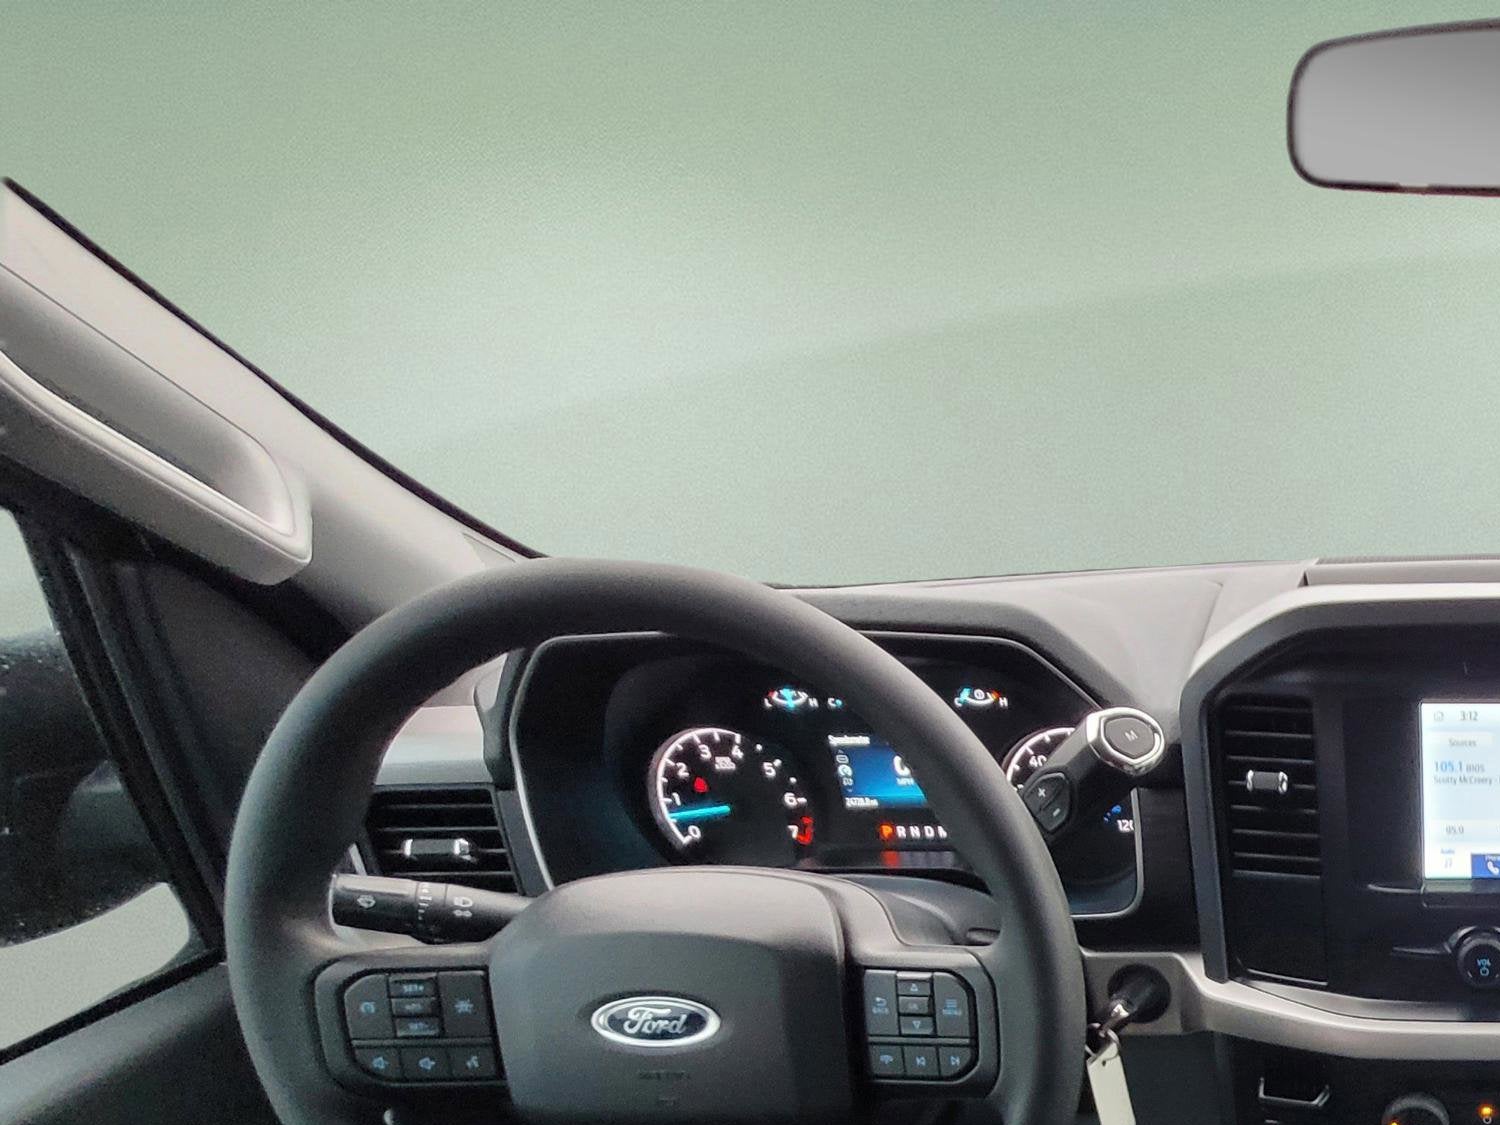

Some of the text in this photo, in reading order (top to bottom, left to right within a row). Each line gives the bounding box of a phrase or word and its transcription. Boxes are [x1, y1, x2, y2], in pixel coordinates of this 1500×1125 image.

[808, 697, 819, 708] H
[999, 697, 1009, 708] H
[1124, 730, 1139, 743] M
[698, 744, 712, 759] 3
[731, 745, 744, 759] 4
[676, 762, 690, 778] 2
[762, 762, 776, 778] 5
[1434, 761, 1463, 773] 105.1
[672, 792, 682, 806] 1
[783, 792, 798, 808] 6
[687, 825, 702, 839] 0
[787, 824, 799, 839] 7
[880, 825, 893, 838] P
[895, 825, 907, 838] R
[909, 825, 921, 838] N
[923, 825, 935, 838] D
[622, 1006, 687, 1035] Ford
